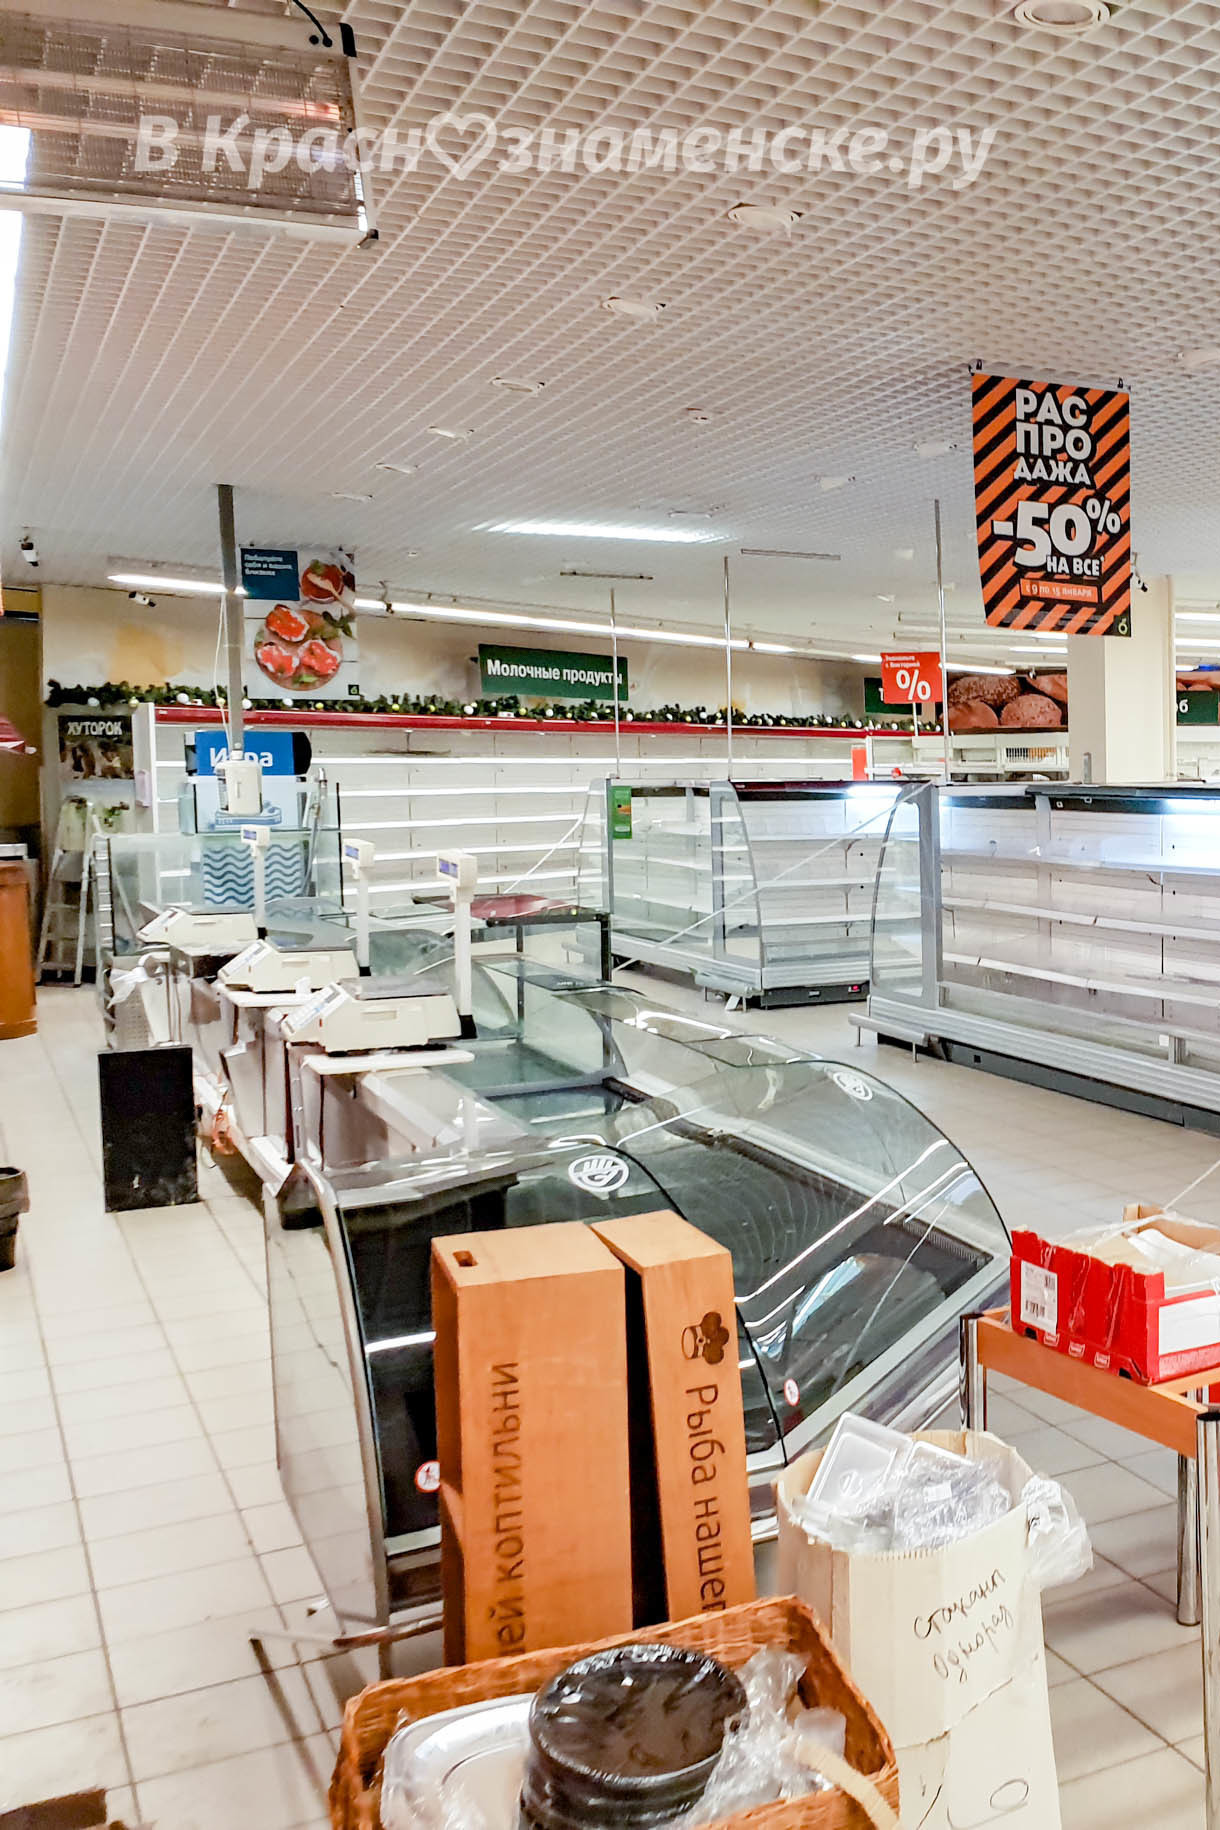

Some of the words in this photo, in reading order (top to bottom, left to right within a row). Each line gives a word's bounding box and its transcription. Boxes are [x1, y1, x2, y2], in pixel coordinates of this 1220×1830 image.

[1016, 388, 1087, 427] РАС
[1016, 421, 1092, 460] ПРО
[1014, 456, 1091, 485] ДАЖА
[1046, 556, 1070, 574] НА
[486, 658, 561, 680] Молочные
[563, 668, 623, 687] продукты
[67, 720, 123, 736] ХУТОРОК
[209, 747, 274, 767] Ира
[685, 1383, 726, 1486] Рыба
[490, 1362, 524, 1584] коптильни
